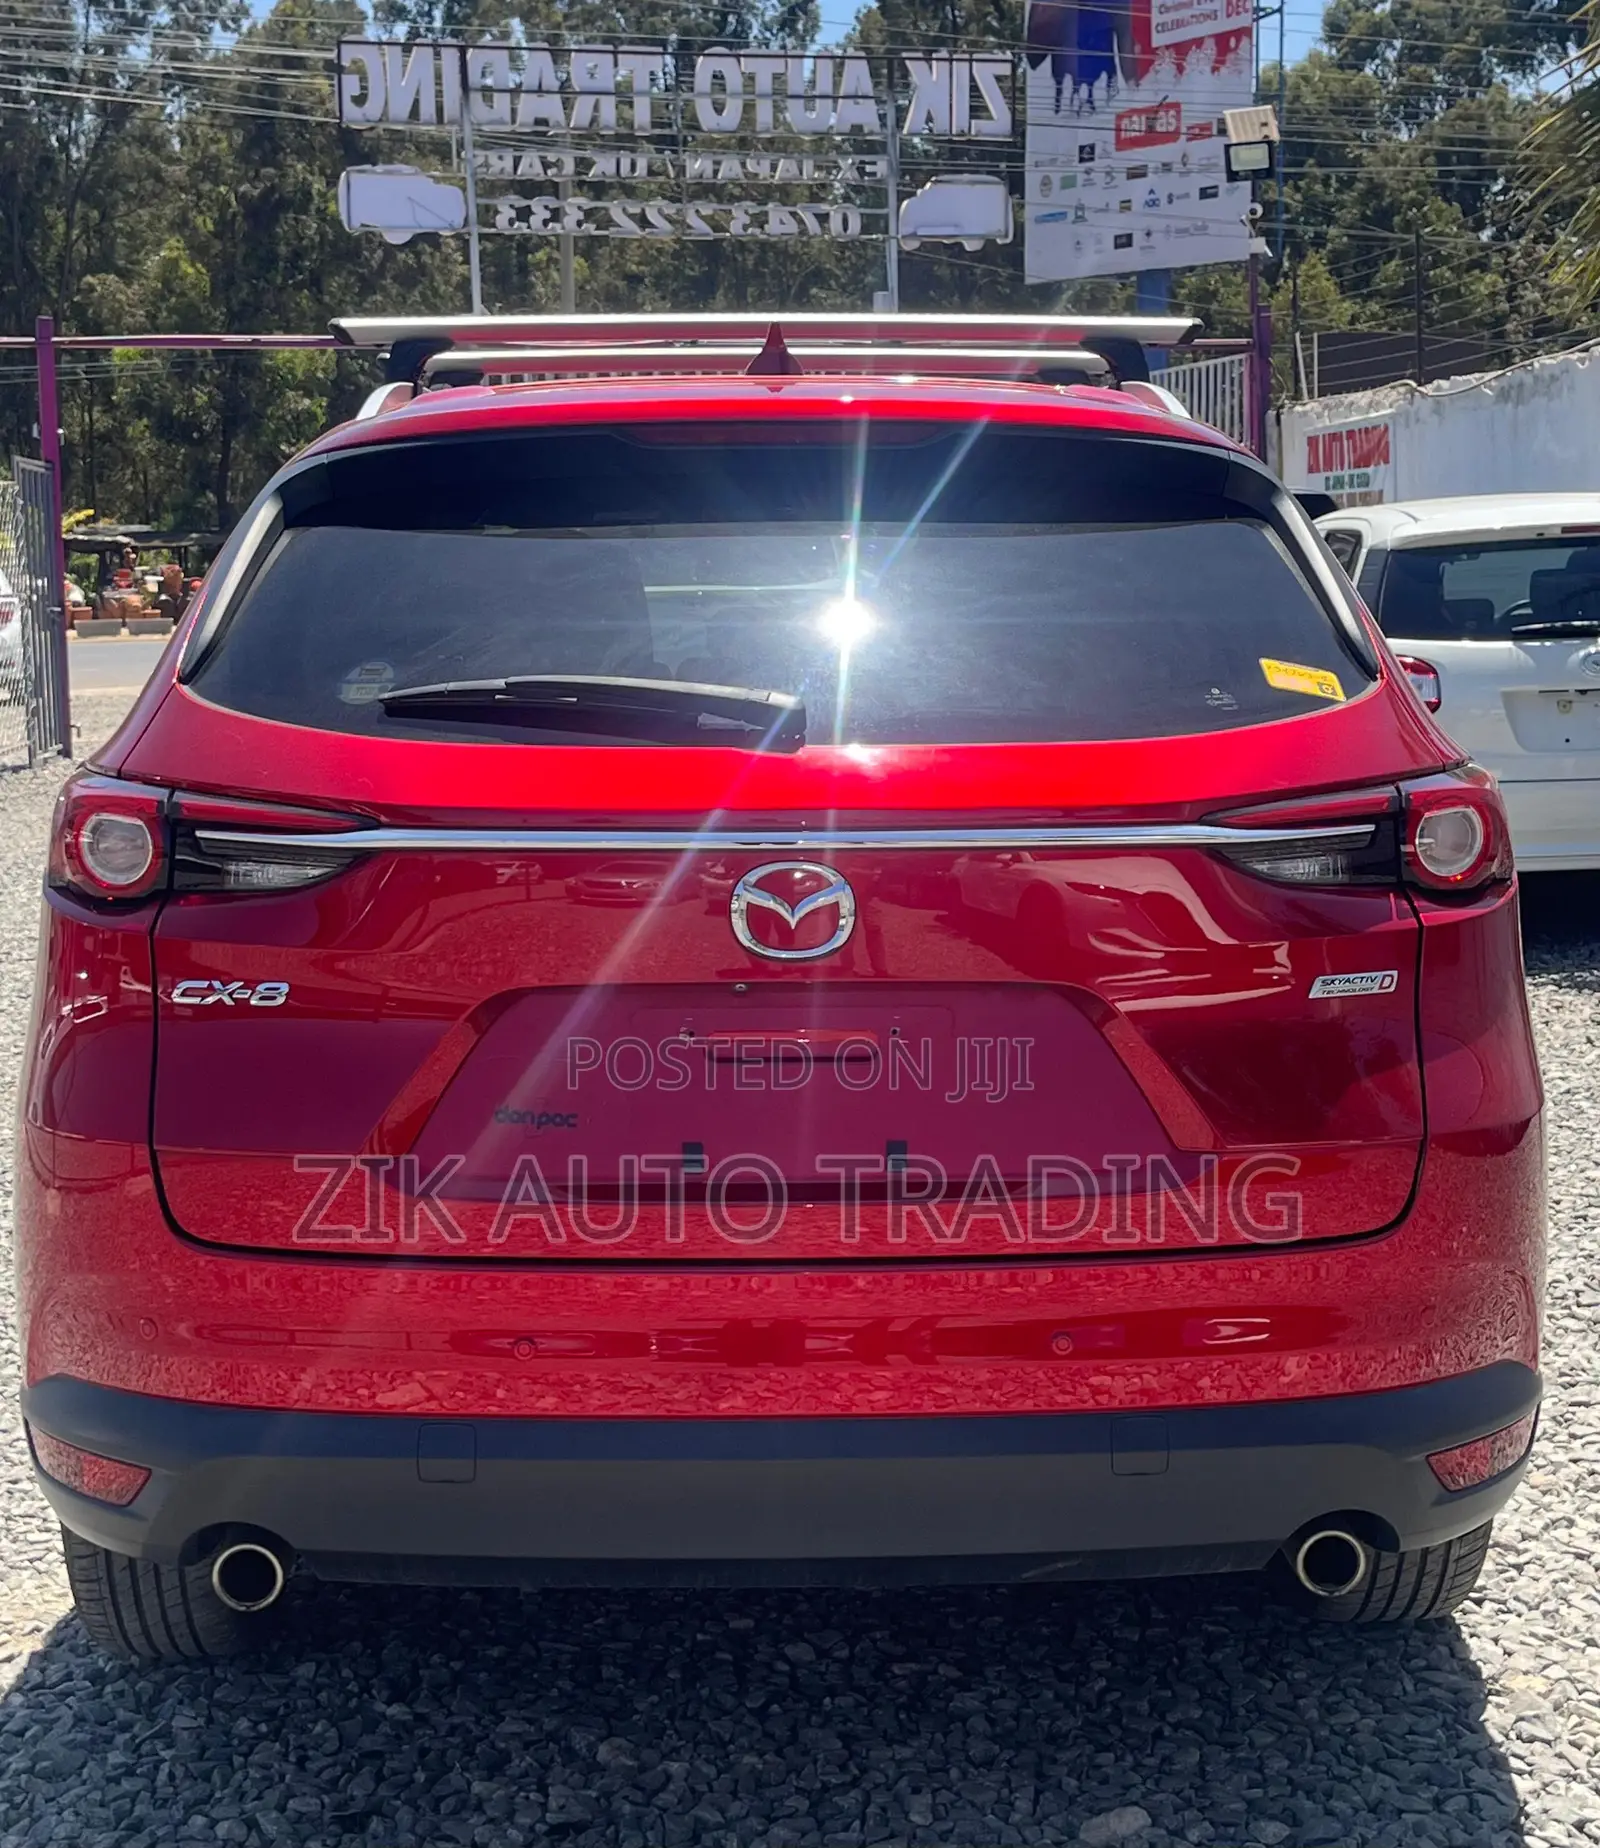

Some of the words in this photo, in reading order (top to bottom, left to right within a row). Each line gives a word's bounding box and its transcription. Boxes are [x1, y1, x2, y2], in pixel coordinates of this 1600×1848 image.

[1320, 976, 1378, 987] SKYACTIV
[1378, 974, 1394, 990] D
[171, 980, 290, 1007] CX-8
[1321, 986, 1375, 996] TECHNOLOGY
